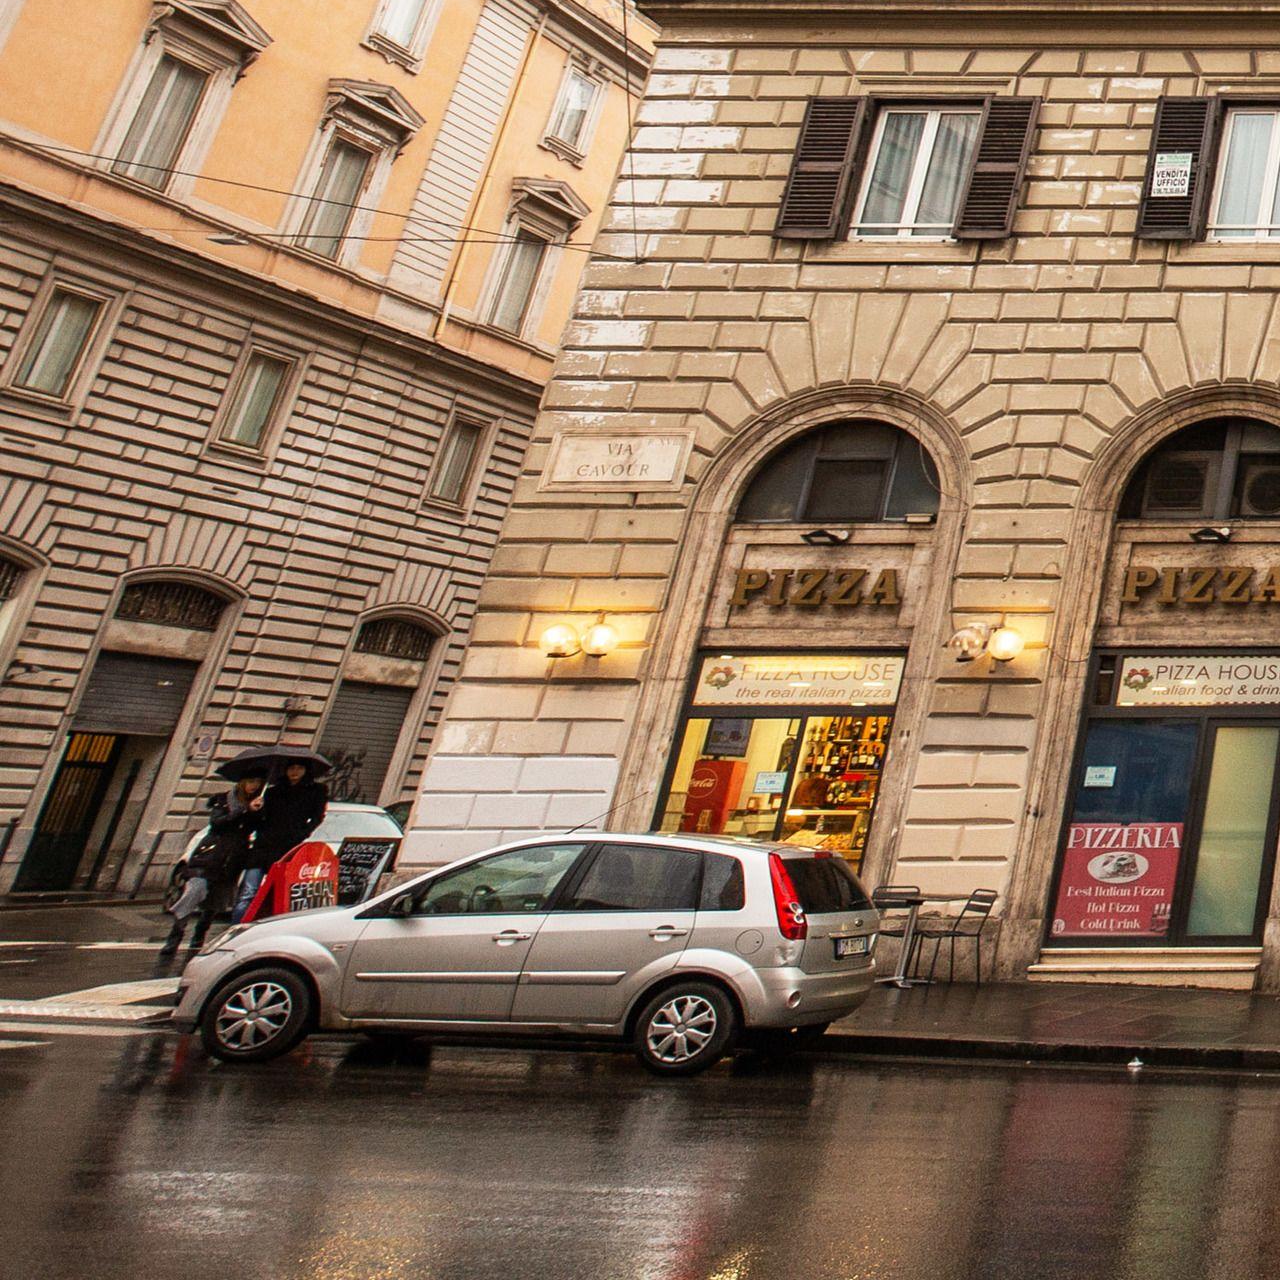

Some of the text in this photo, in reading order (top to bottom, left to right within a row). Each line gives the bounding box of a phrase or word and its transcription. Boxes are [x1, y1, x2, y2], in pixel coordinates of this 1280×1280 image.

[1156, 169, 1188, 178] VENDITA
[1157, 178, 1186, 187] UFFICIO
[608, 443, 633, 456] VIA
[576, 463, 650, 477] CAVOUR
[727, 568, 901, 607] PIZZA
[812, 663, 896, 681] HOUSE
[1155, 665, 1210, 681] PIZZA
[736, 687, 891, 701] the real italian pizza
[1199, 684, 1234, 696] food
[1237, 685, 1248, 696] &
[1067, 827, 1182, 849] PIZZERIA
[290, 881, 334, 897] SPECIAL
[1067, 887, 1165, 897] Best Italian Pizza
[1087, 903, 1140, 913] Hot Pizza
[1080, 919, 1141, 930] Cold Drink
